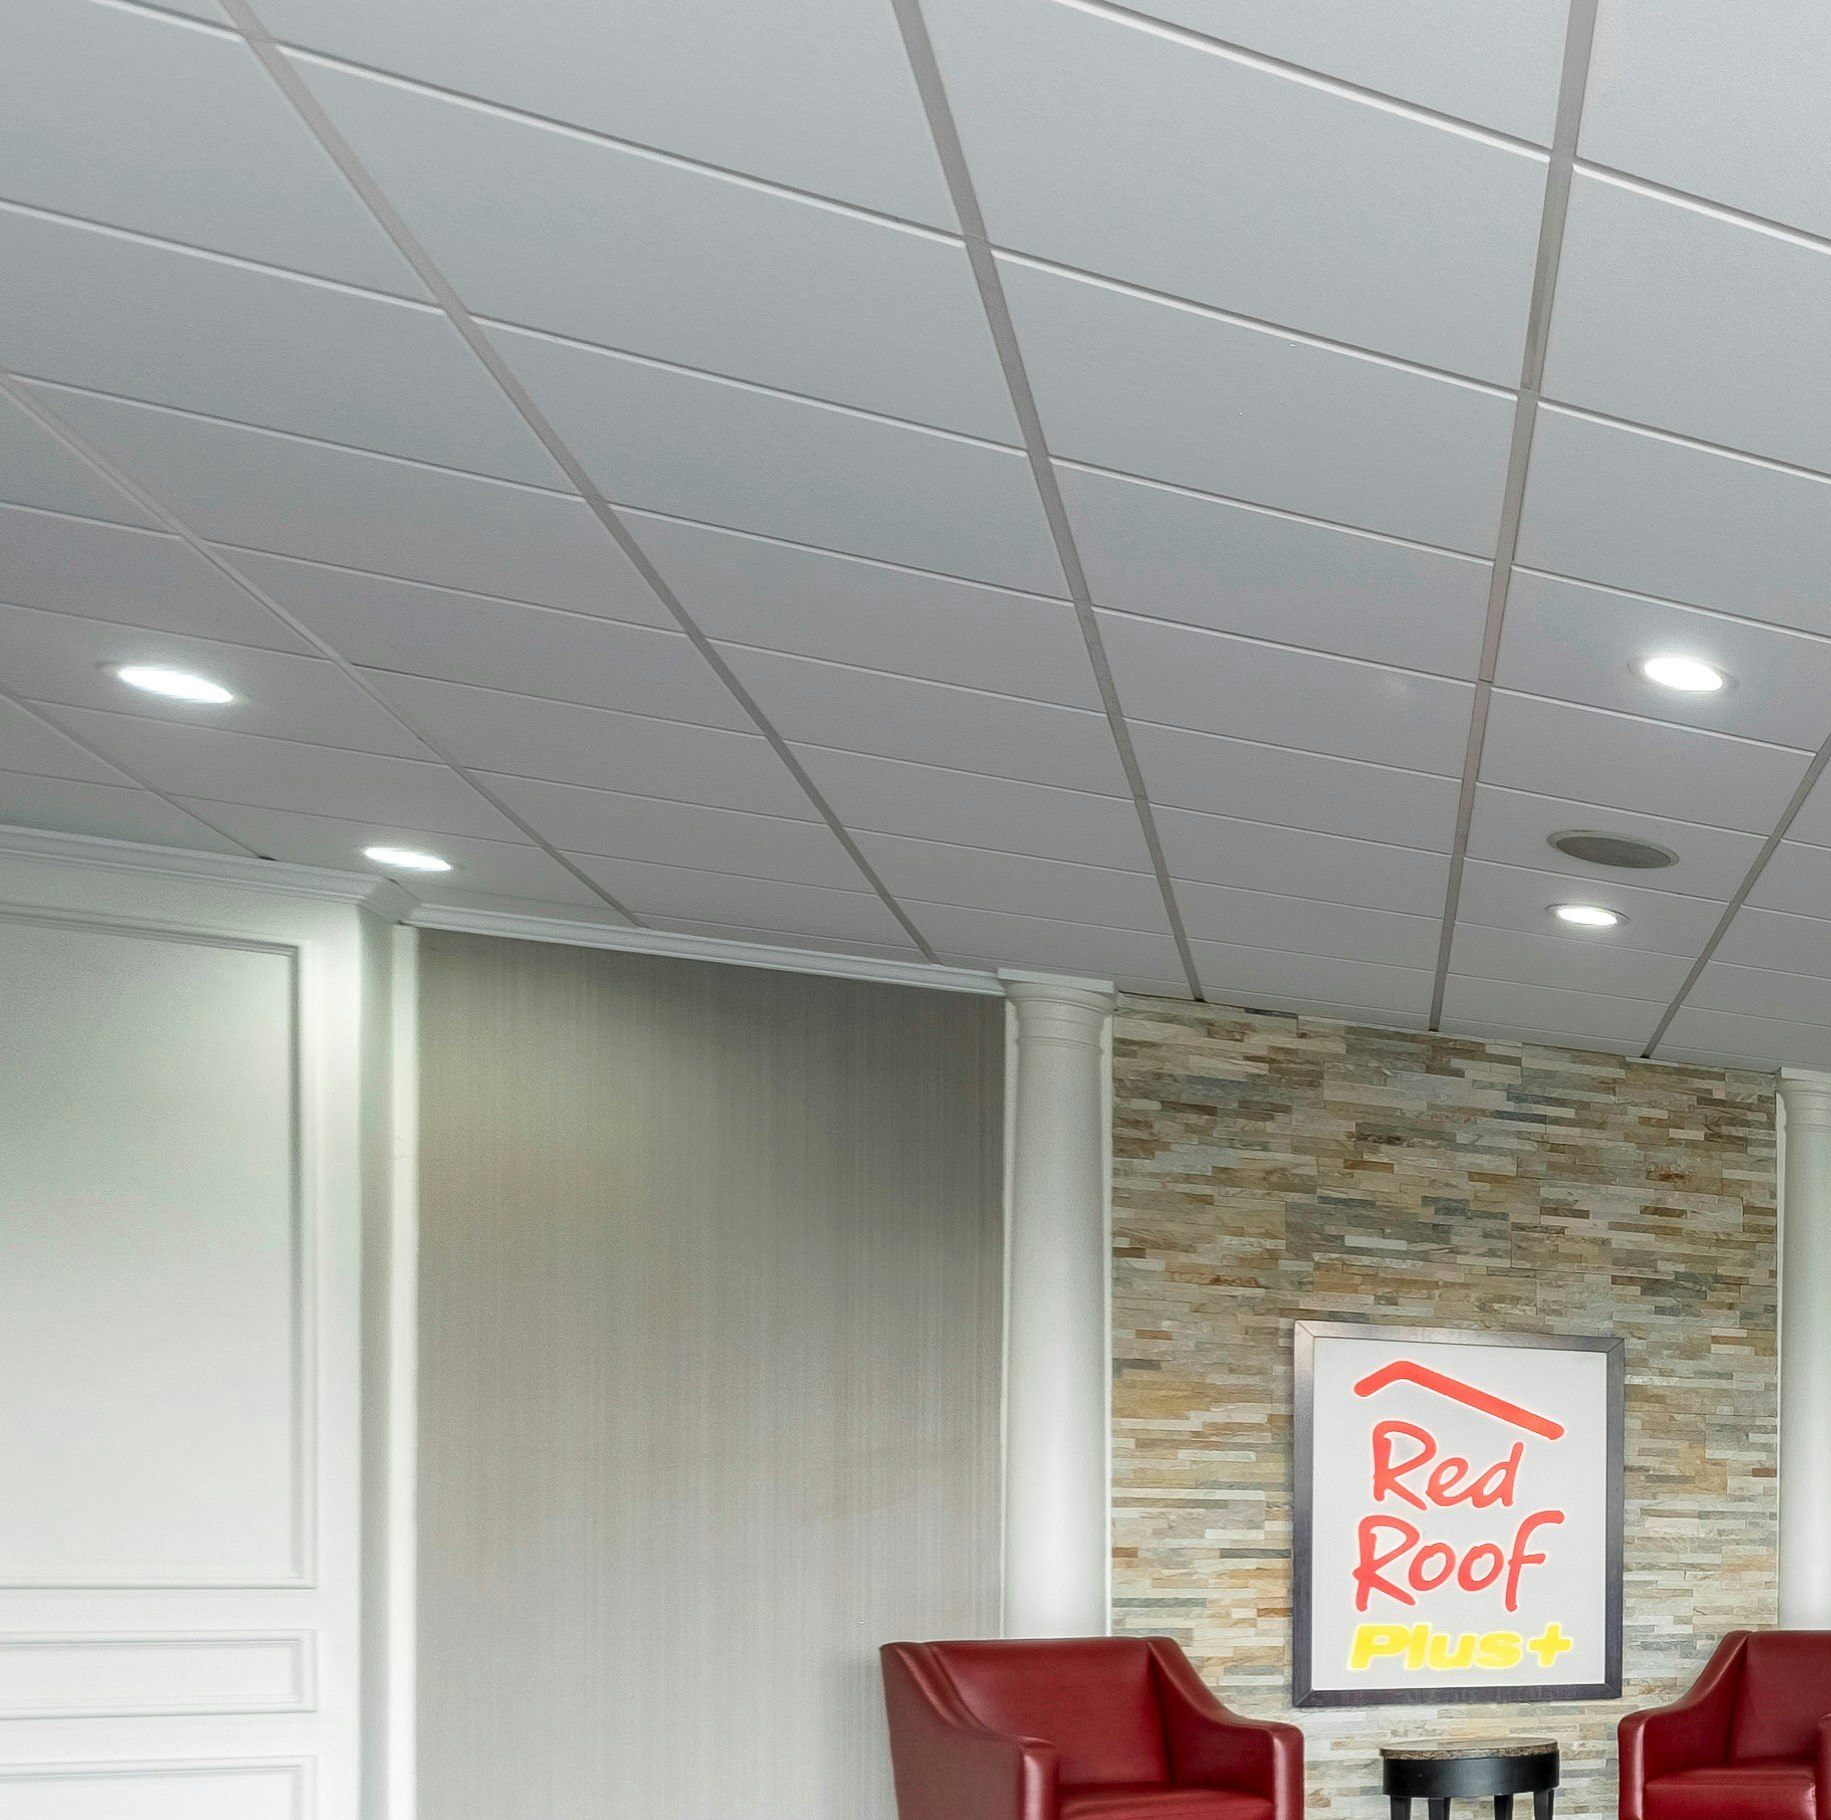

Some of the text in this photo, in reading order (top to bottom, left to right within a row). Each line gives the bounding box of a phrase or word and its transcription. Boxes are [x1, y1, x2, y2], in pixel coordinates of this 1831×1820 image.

[1372, 1420, 1525, 1511] Red
[1352, 1509, 1566, 1613] Roof
[1348, 1622, 1572, 1671] Plus+
